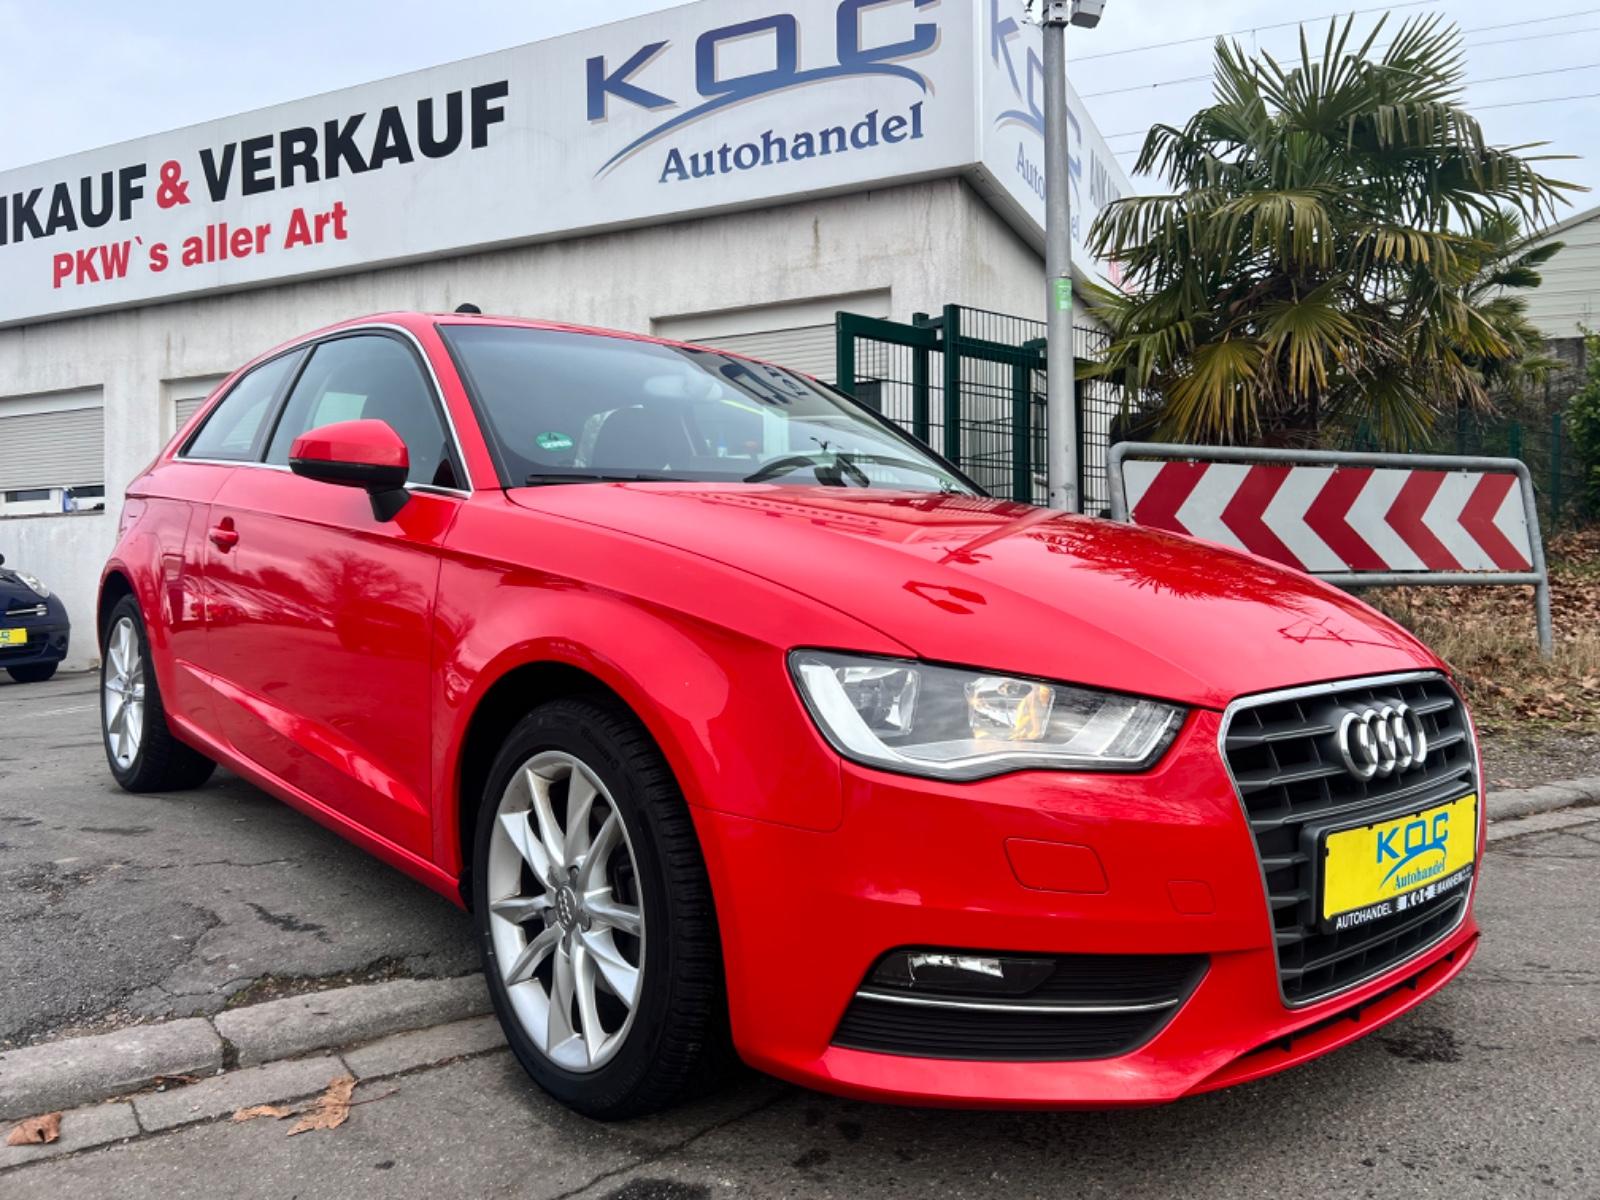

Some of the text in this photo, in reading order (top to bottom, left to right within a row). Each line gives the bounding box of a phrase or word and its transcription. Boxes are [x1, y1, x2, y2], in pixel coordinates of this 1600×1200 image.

[156, 159, 191, 209] &
[199, 80, 509, 203] VERKAUF
[658, 101, 924, 183] Autohandel
[181, 221, 271, 271] aller
[283, 201, 348, 249] Art
[1393, 857, 1446, 890] Autohandel
[1335, 902, 1392, 930] AUTOHANDEL
